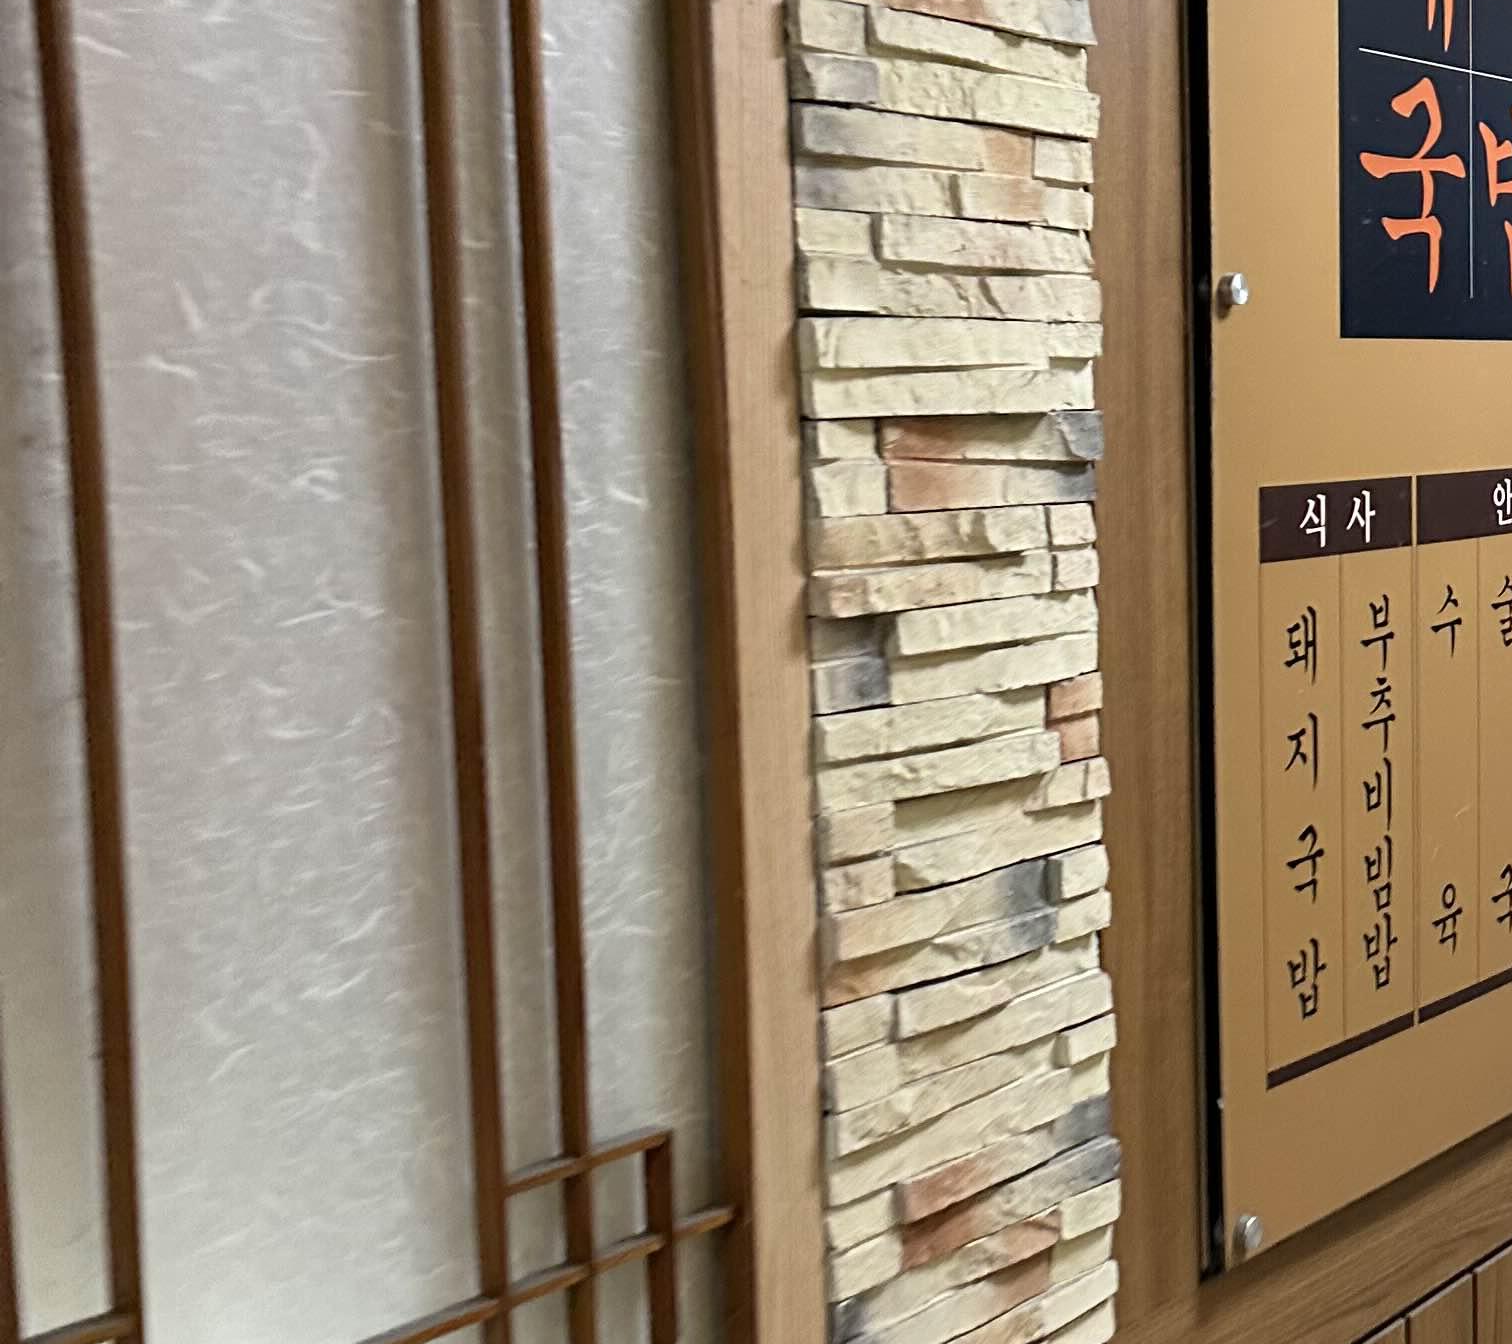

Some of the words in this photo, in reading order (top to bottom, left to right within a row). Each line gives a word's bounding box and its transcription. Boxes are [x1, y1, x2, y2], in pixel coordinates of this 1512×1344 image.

[1299, 490, 1376, 548] 식사
[1284, 605, 1327, 1021] 돼지국밥
[1360, 594, 1398, 990] 부추비빔밥
